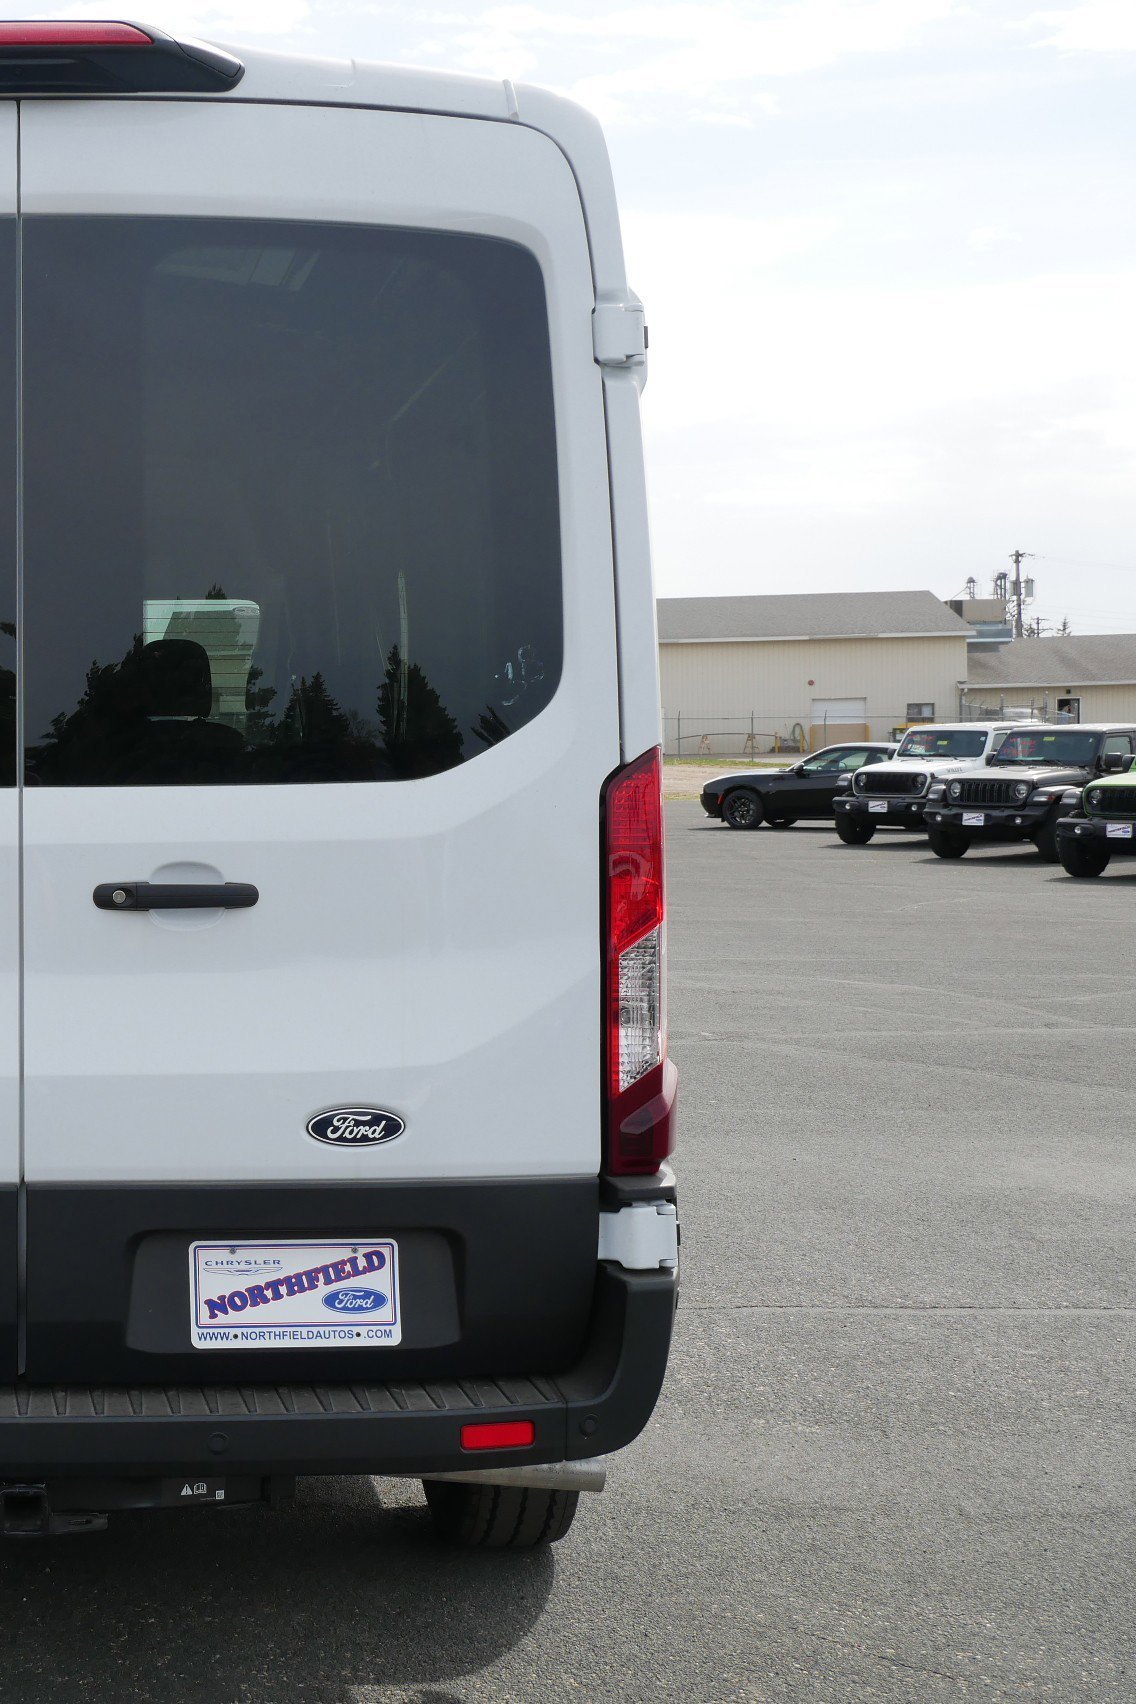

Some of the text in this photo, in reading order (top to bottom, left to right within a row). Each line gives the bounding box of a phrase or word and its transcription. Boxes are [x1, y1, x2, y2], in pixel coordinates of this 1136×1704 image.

[326, 1114, 387, 1139] Ford
[204, 1258, 282, 1267] CHRYSLER
[204, 1249, 387, 1320] NORTHFIELD
[334, 1291, 374, 1309] Ford
